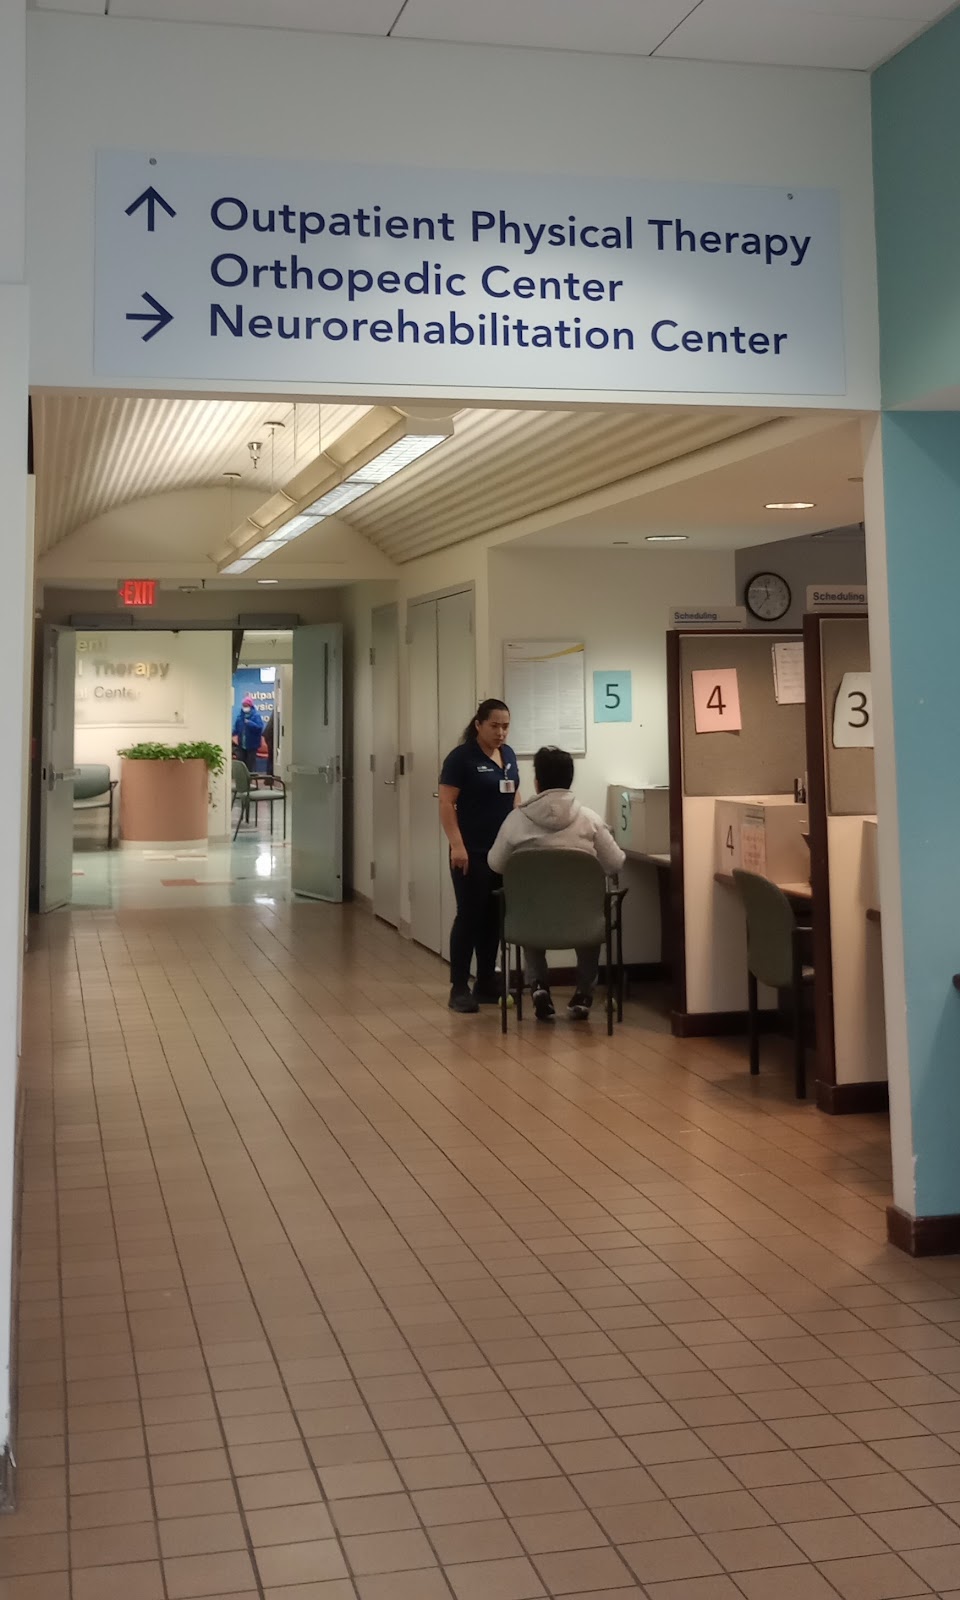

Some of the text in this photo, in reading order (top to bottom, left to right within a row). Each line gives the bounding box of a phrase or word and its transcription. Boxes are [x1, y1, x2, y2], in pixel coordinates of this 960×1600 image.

[210, 196, 812, 267] Outpatient Physical Therapy
[210, 252, 624, 304] Orthopedic Center
[210, 303, 789, 356] Neurorehabilitation Center
[124, 581, 155, 605] EXIT
[812, 591, 865, 603] Scheduling
[673, 611, 718, 621] Scheduling
[92, 660, 170, 681] Therapy
[604, 683, 621, 709] 5
[706, 685, 727, 715] 4
[847, 691, 870, 728] 3
[620, 804, 629, 832] 5
[725, 825, 735, 856] 4
